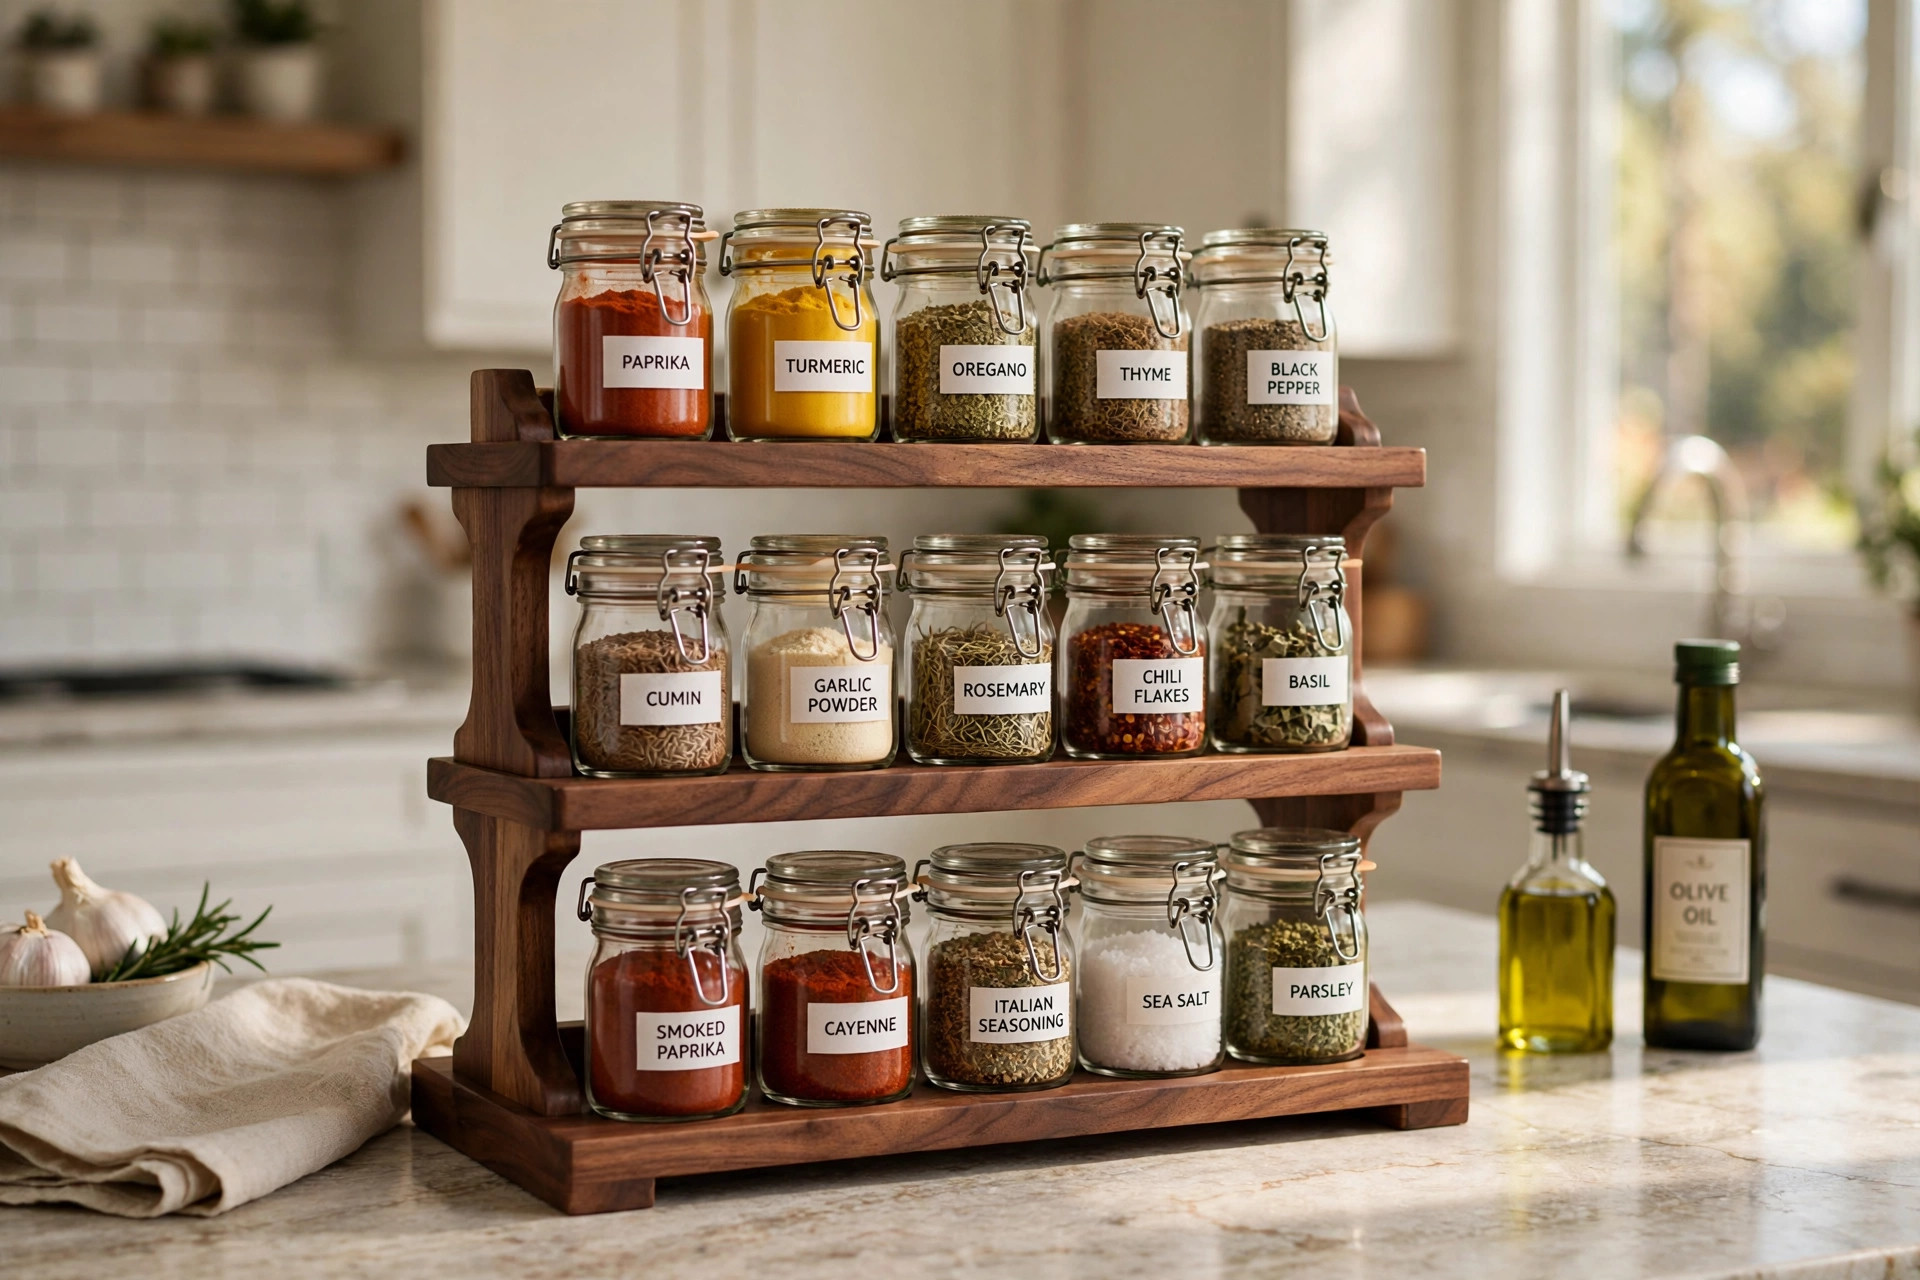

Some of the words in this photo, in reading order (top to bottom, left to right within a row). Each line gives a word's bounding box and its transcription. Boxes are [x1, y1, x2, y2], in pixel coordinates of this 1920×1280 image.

[622, 354, 690, 370] PAPRIKA
[784, 358, 865, 375] TURMERIC
[952, 361, 1027, 378] OREGANO
[1271, 362, 1318, 377] BLACK
[1119, 366, 1171, 382] THYME
[1267, 380, 1320, 395] PEPPER
[813, 677, 872, 694] GARLIC
[1142, 669, 1182, 685] CHILI
[1289, 674, 1330, 689] BASIL
[963, 681, 1046, 698] ROSEMARY
[1134, 688, 1190, 704] FLAKES
[645, 690, 701, 707] CUMIN
[808, 696, 878, 713] POWDER
[1670, 882, 1728, 901] OLIVE
[1683, 906, 1717, 926] OIL
[1290, 982, 1352, 999] PARSLEY
[994, 995, 1053, 1014] ITALIAN
[1142, 994, 1173, 1009] SEA
[1177, 990, 1210, 1008] SALT
[656, 1020, 725, 1040] SMOKED
[824, 1016, 897, 1036] CAYENNE
[977, 1012, 1064, 1034] SEASONING
[657, 1041, 725, 1060] PAPRIKA
